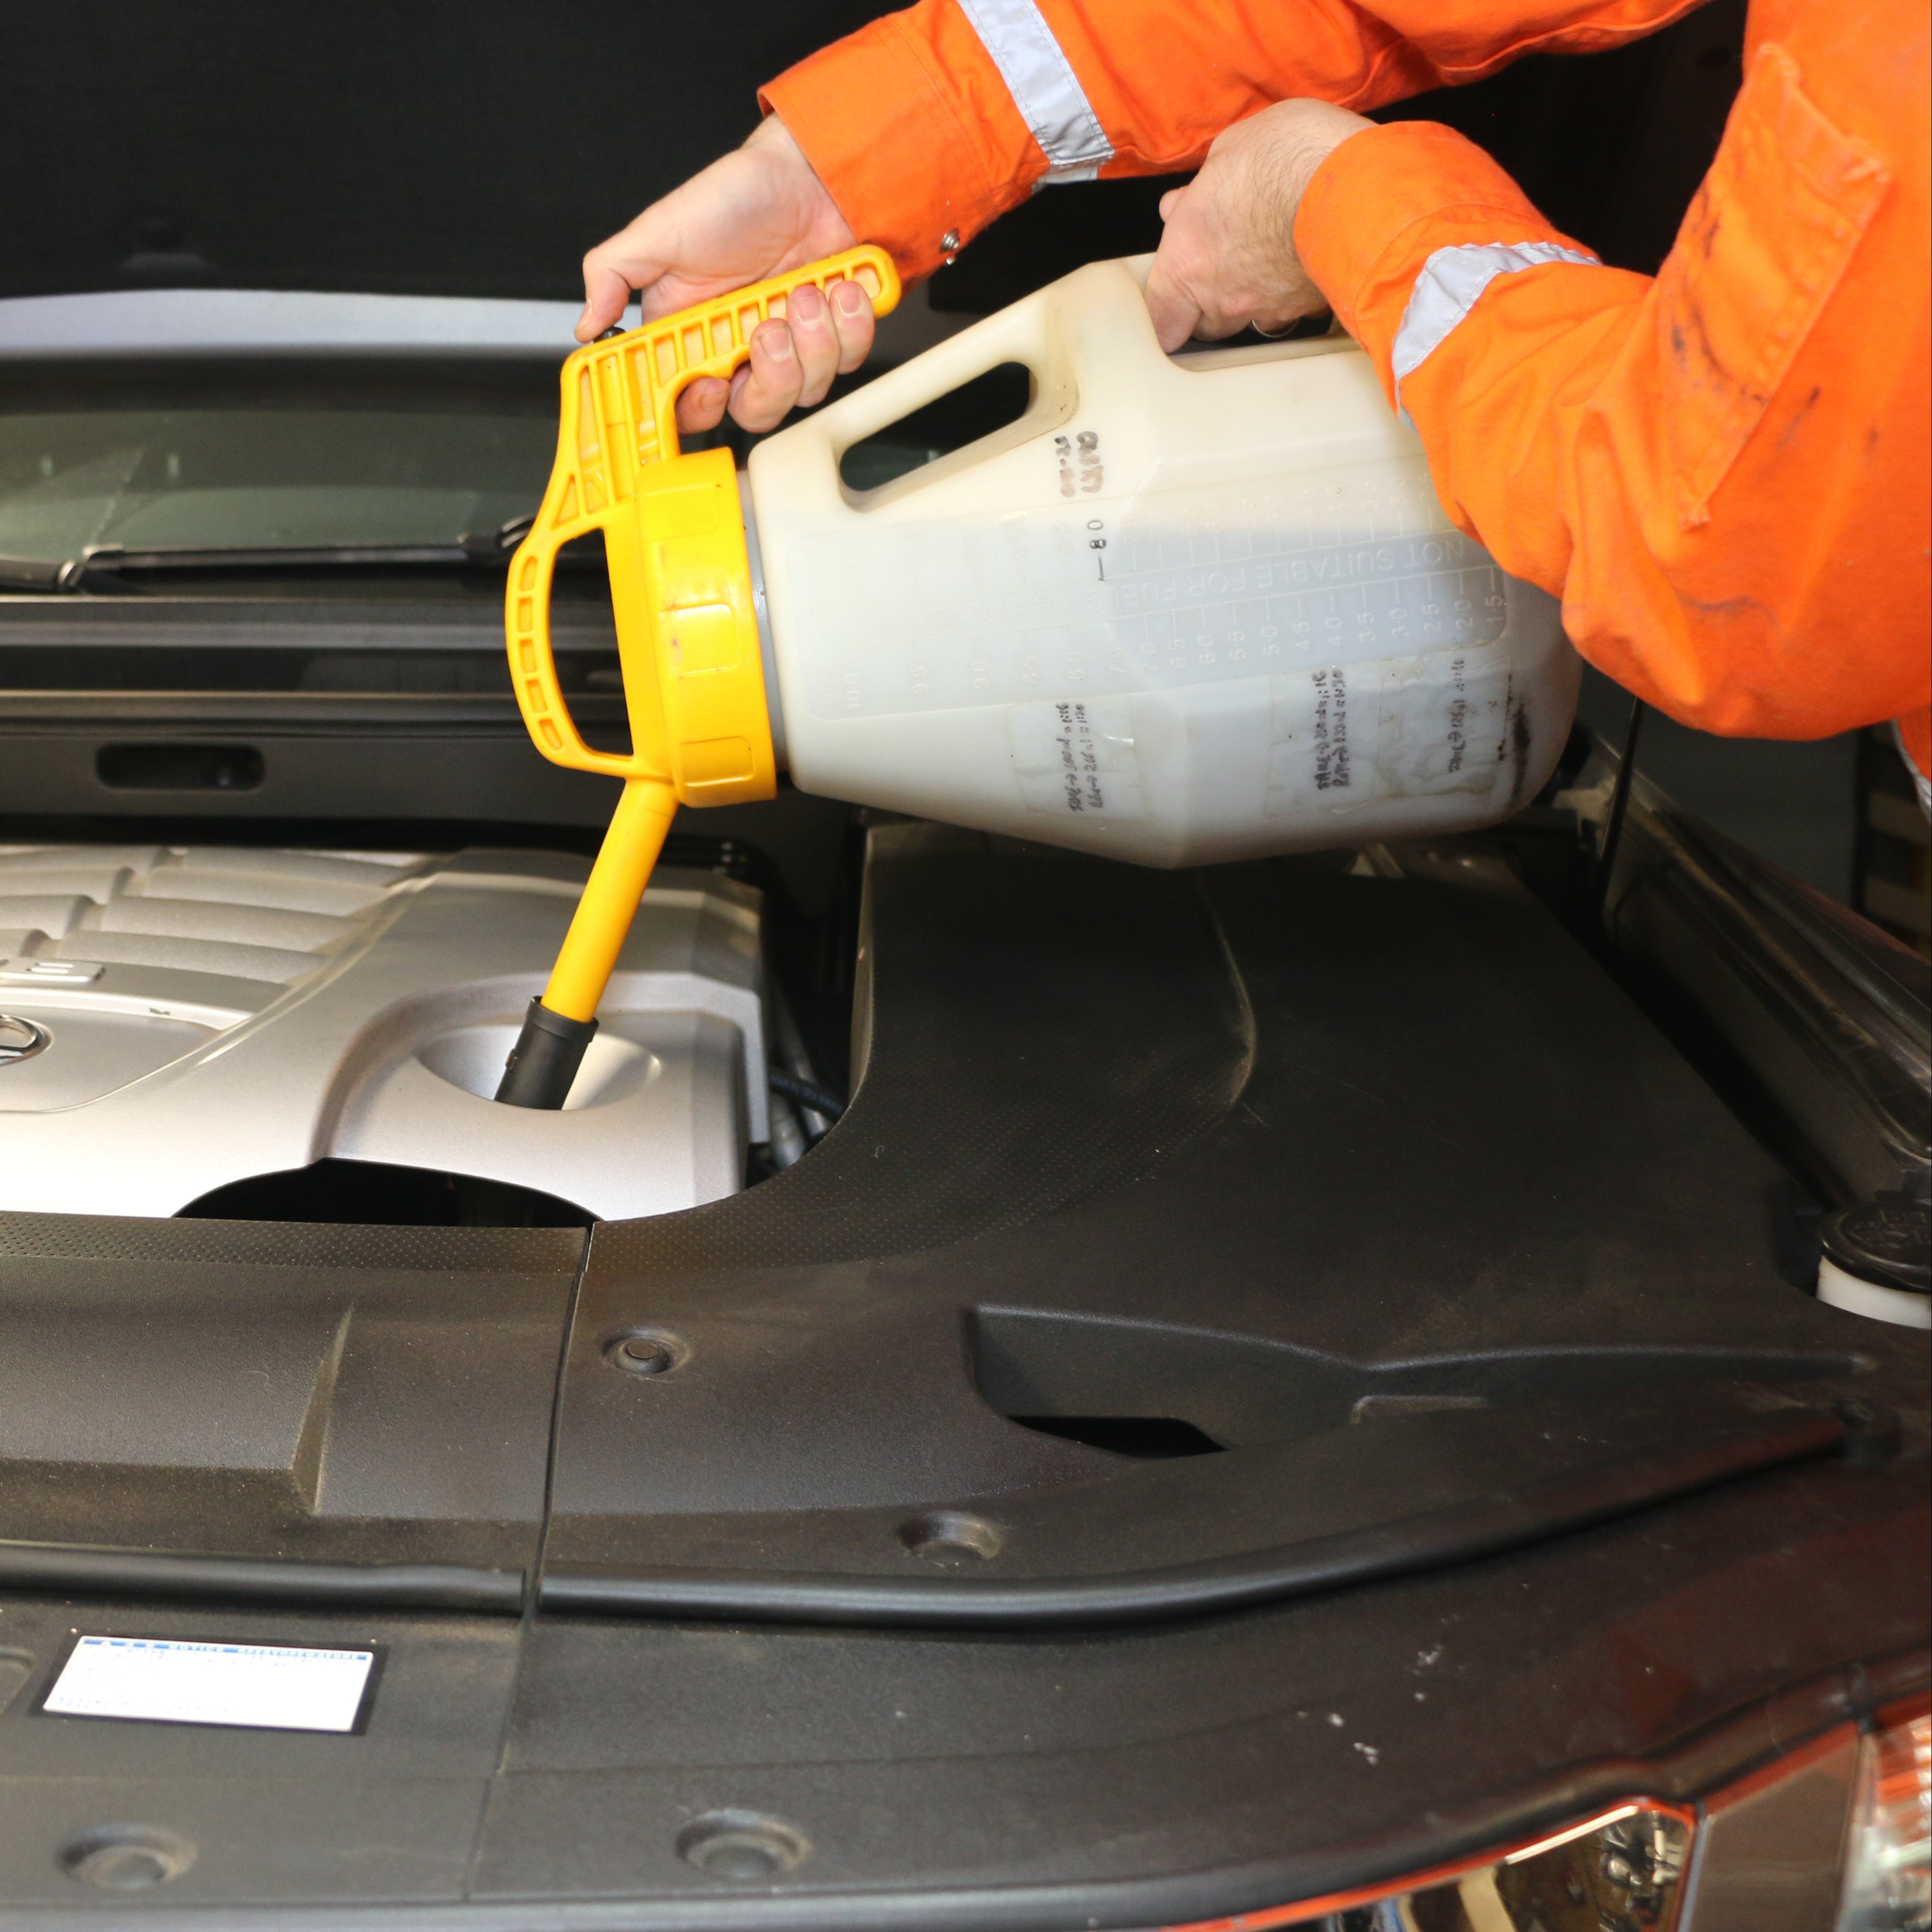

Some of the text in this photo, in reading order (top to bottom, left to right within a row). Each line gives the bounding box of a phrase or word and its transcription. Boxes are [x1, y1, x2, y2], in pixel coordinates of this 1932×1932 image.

[872, 537, 1465, 636] NOT SUITABLE FOR FUELS OR SOLVENTS
